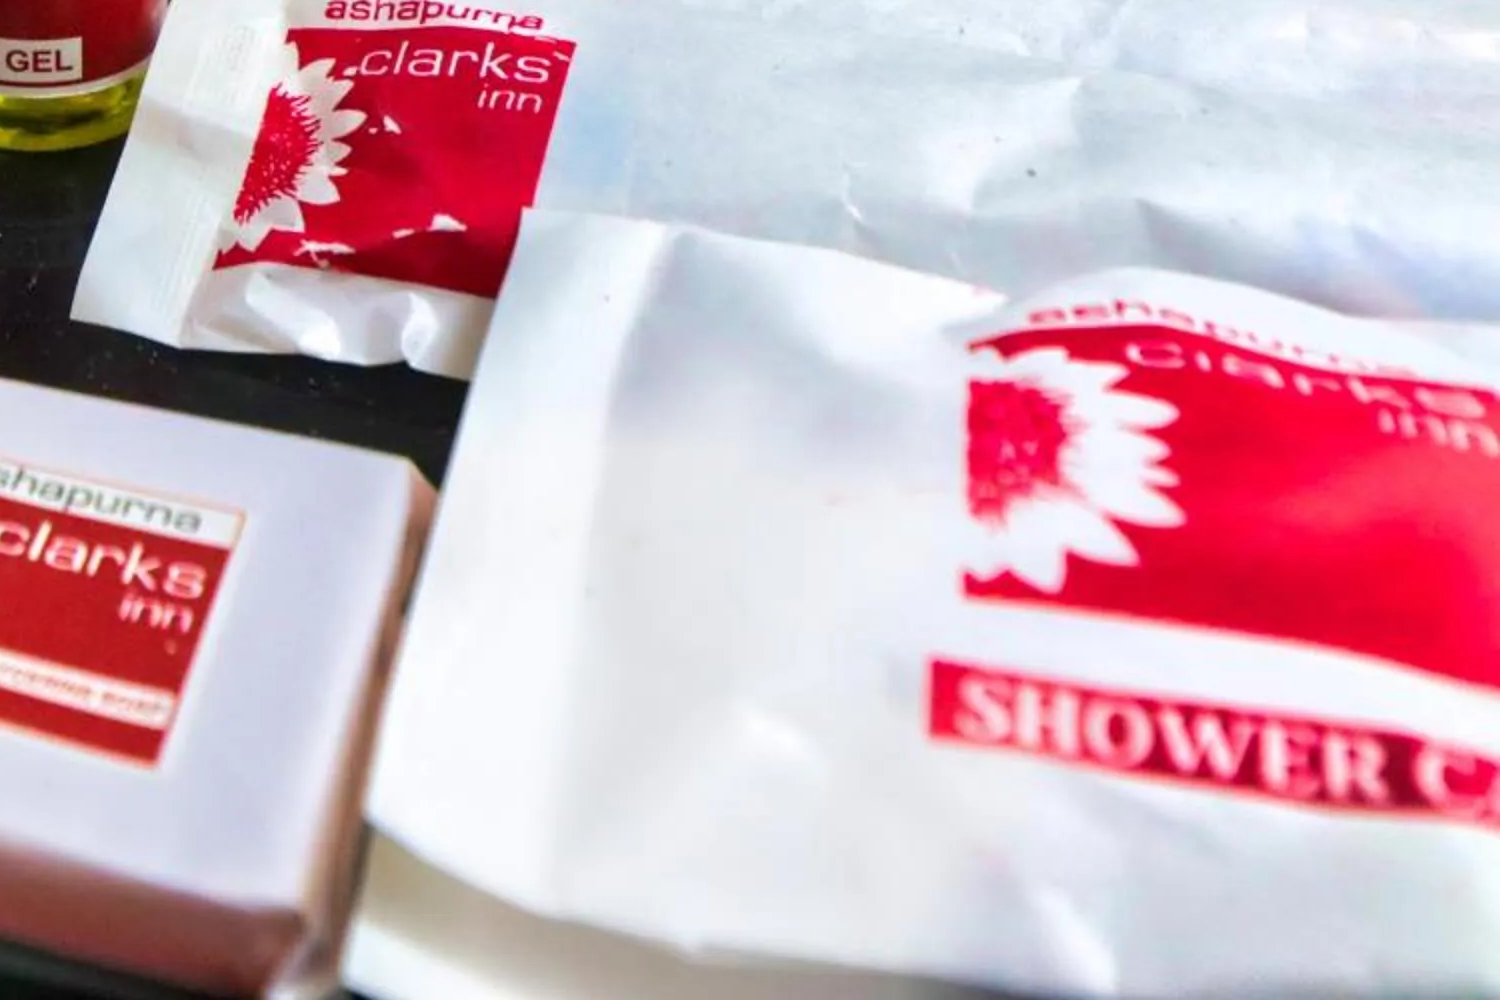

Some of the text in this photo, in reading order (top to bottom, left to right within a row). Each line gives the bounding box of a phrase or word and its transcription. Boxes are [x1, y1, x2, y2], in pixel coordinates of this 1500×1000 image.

[5, 49, 74, 73] GEL
[359, 41, 550, 84] clarks
[476, 84, 543, 114] inn
[118, 591, 195, 634] inn
[953, 674, 1389, 804] SHOWER
